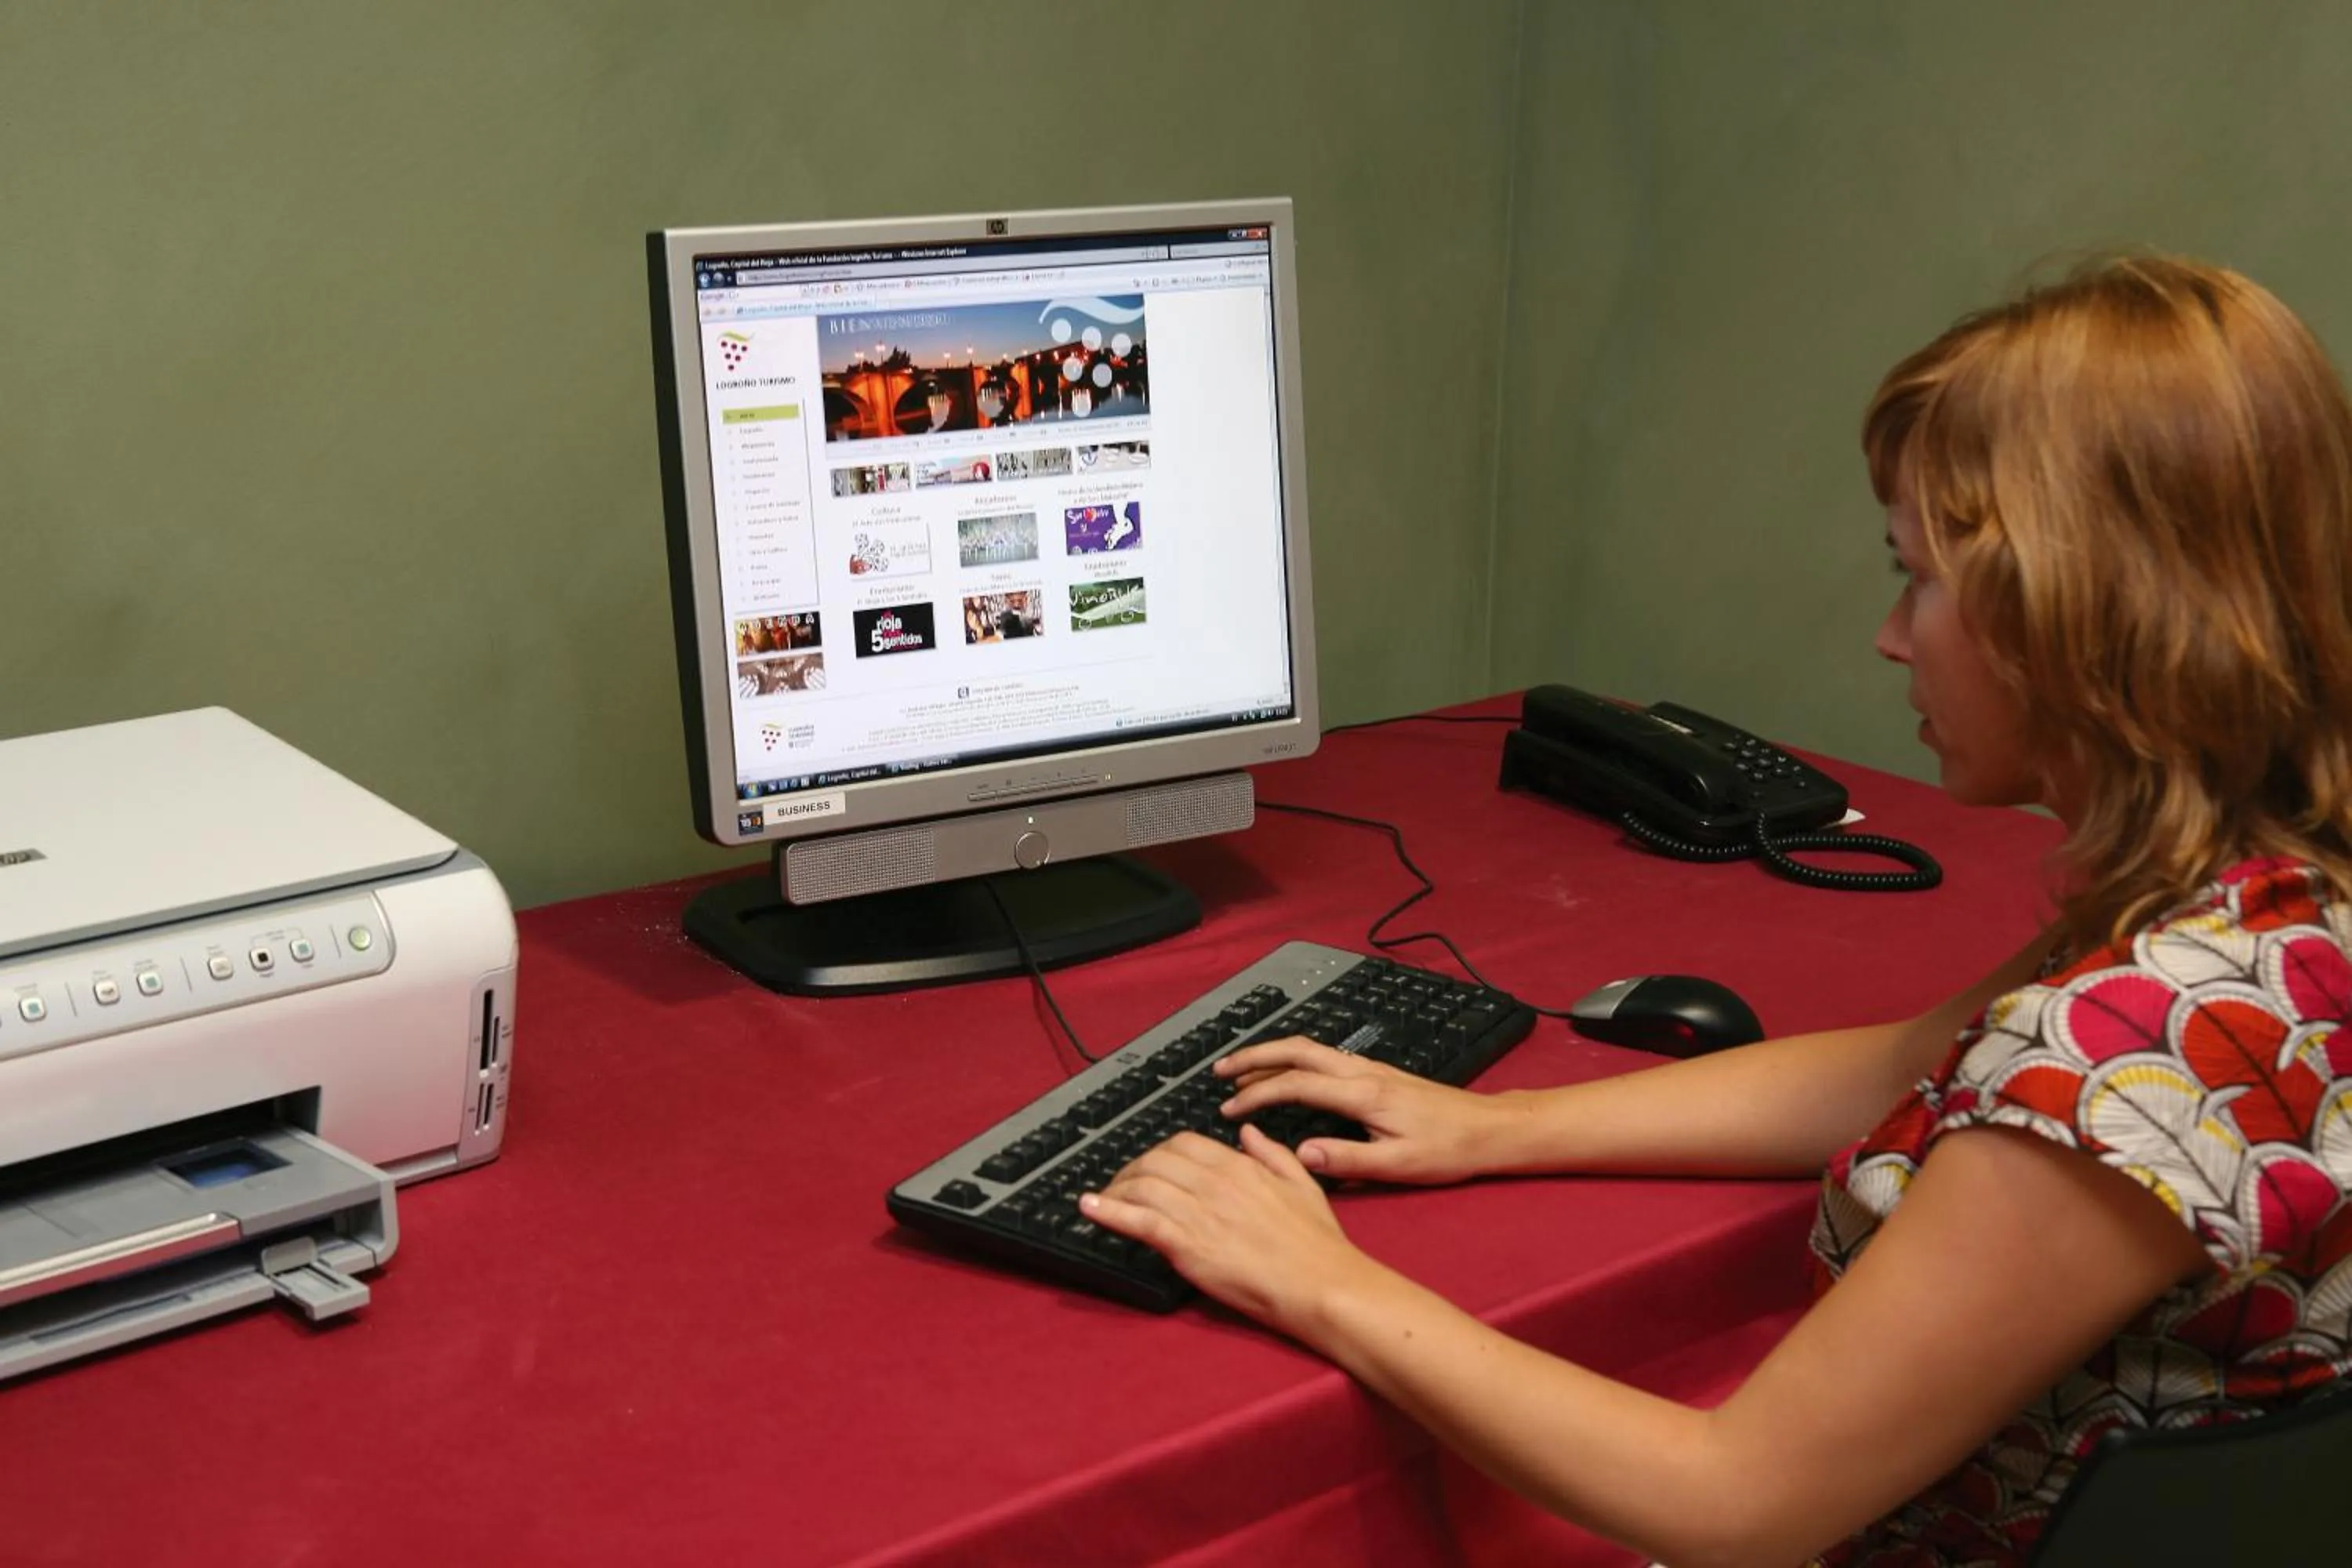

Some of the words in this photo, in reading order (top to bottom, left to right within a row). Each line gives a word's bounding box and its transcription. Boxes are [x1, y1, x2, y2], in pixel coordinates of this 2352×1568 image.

[758, 376, 797, 387] TURISMO
[871, 630, 884, 652] 5
[777, 800, 831, 816] BUSINESS
